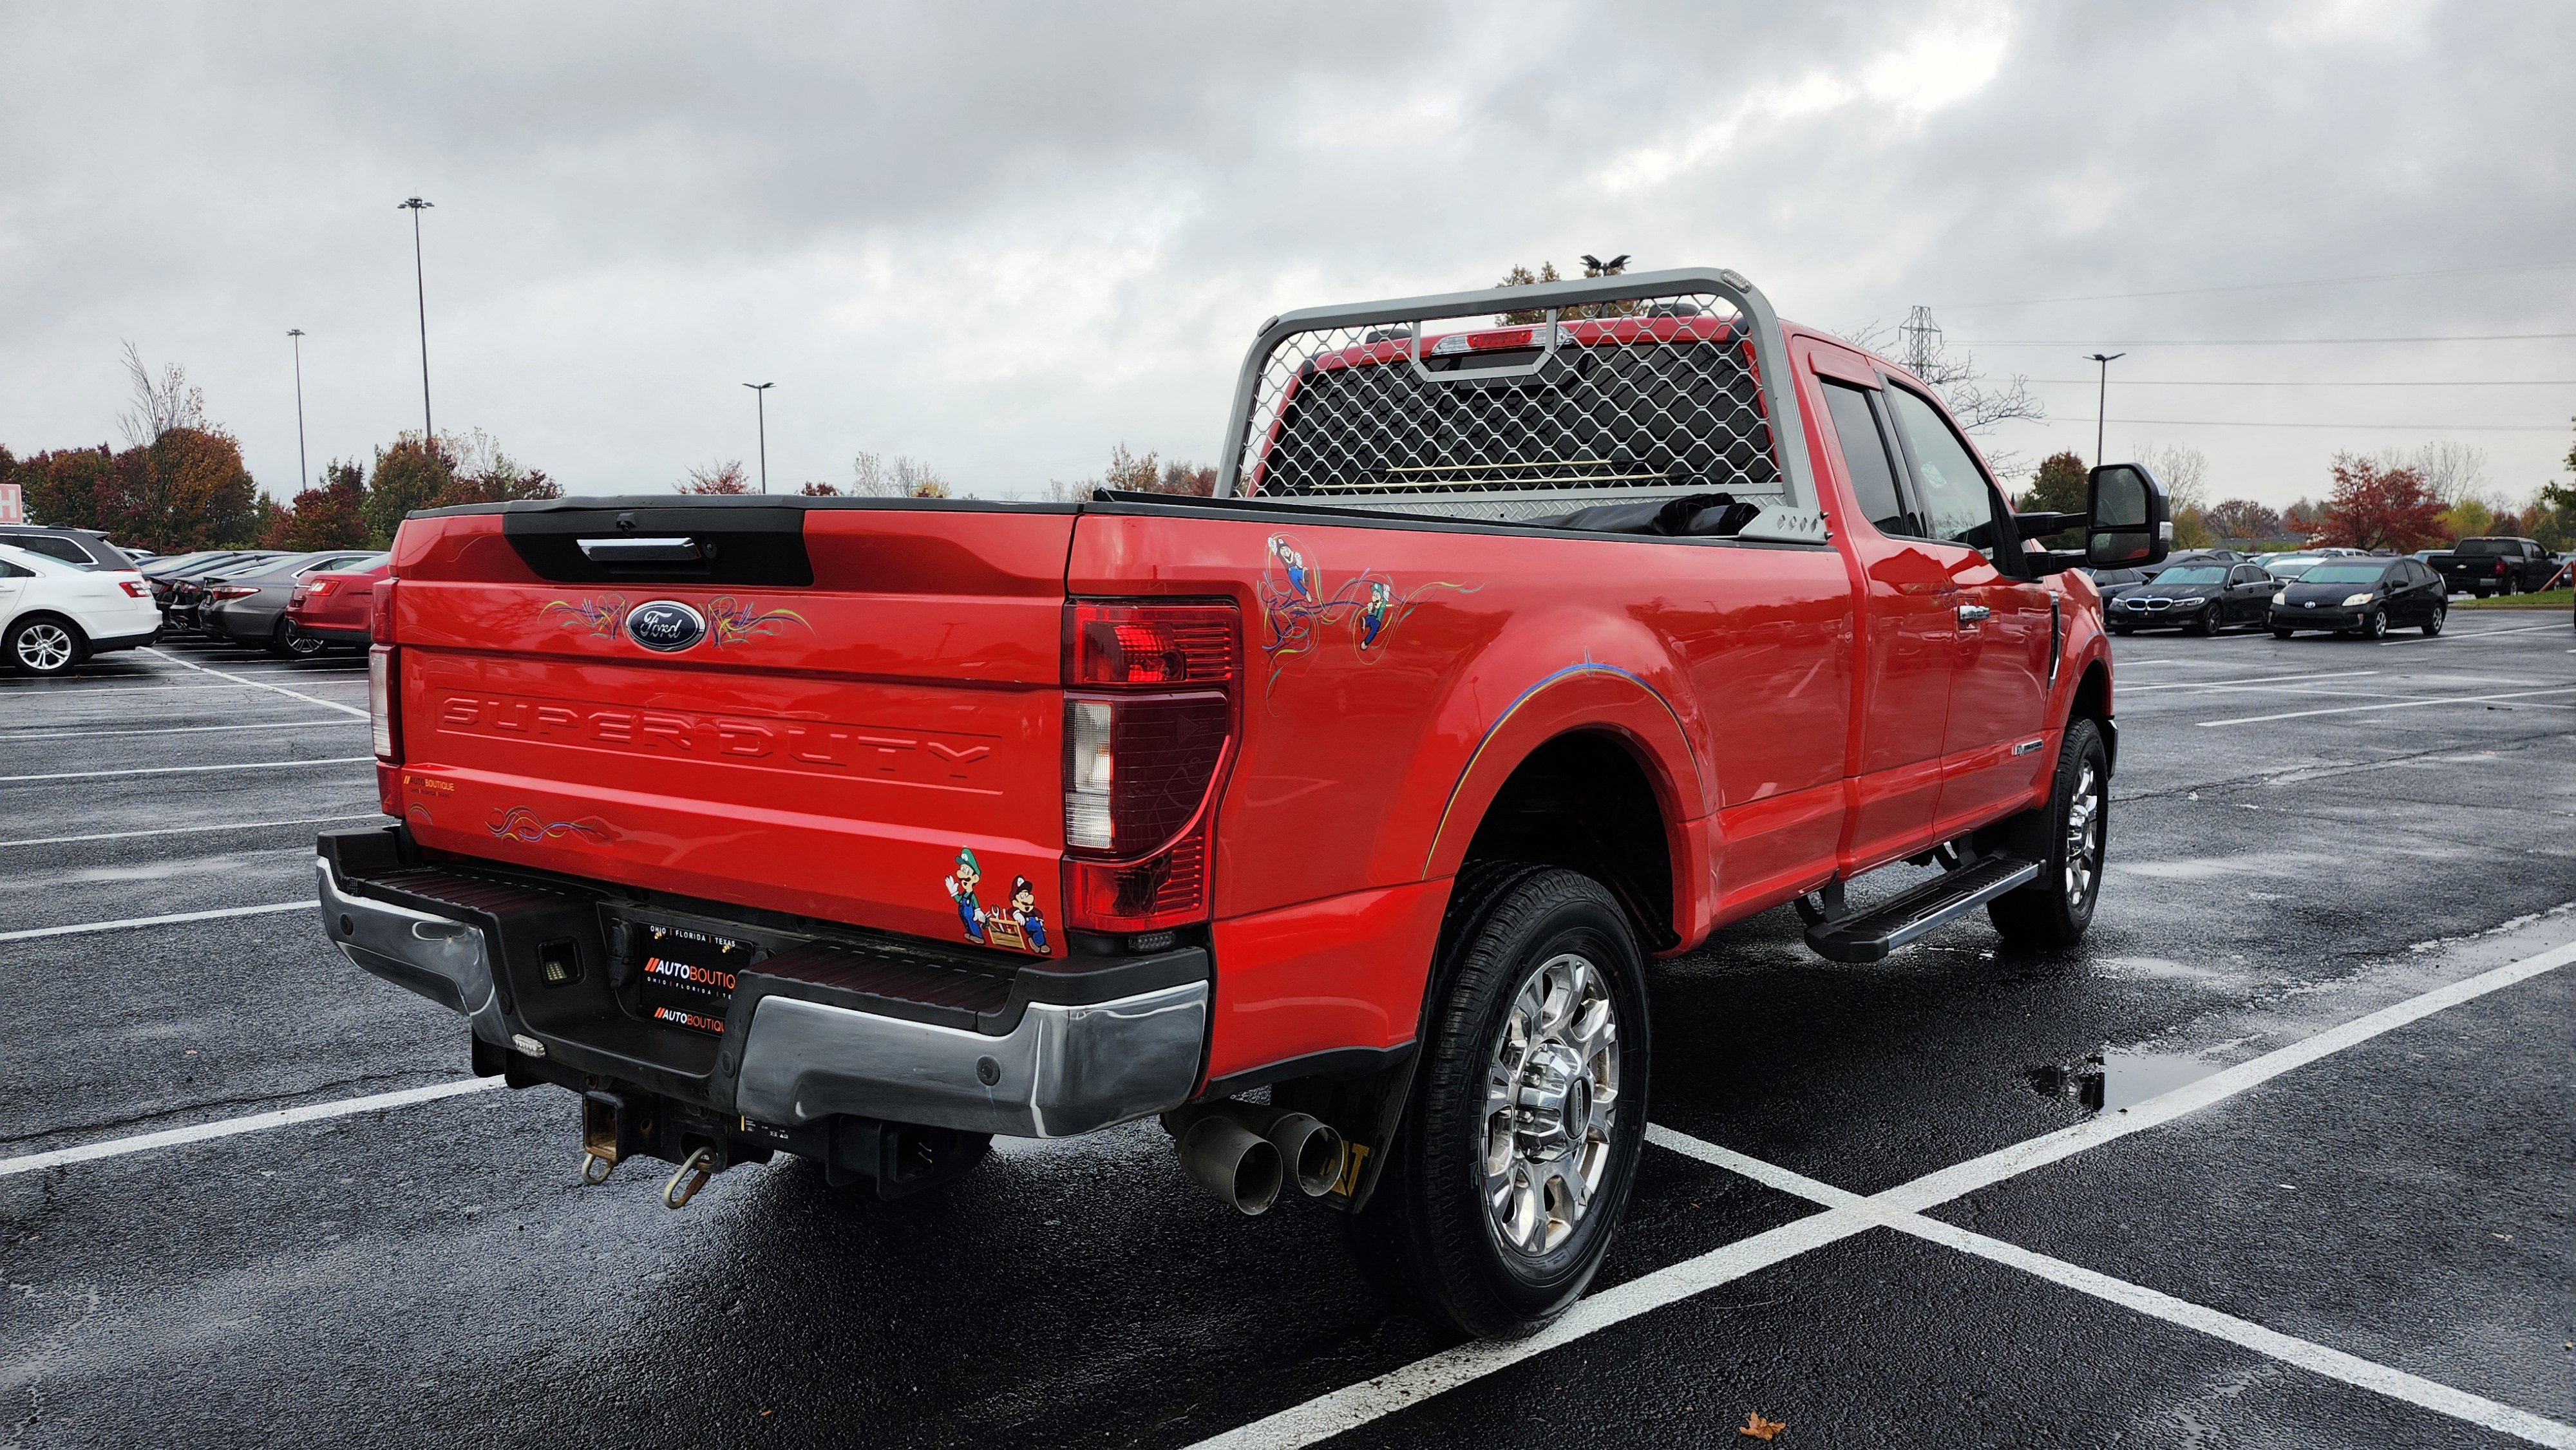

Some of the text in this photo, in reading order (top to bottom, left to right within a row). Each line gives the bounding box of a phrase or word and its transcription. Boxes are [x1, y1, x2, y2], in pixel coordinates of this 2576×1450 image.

[640, 610, 683, 639] Ford
[444, 697, 990, 778] SUPER DUTY
[650, 925, 735, 947] OHIO FLORIDA TEXAS
[647, 976, 667, 985] OHIO
[676, 983, 711, 995] FLORIDA
[656, 959, 736, 990] AUTOBOUTIQ
